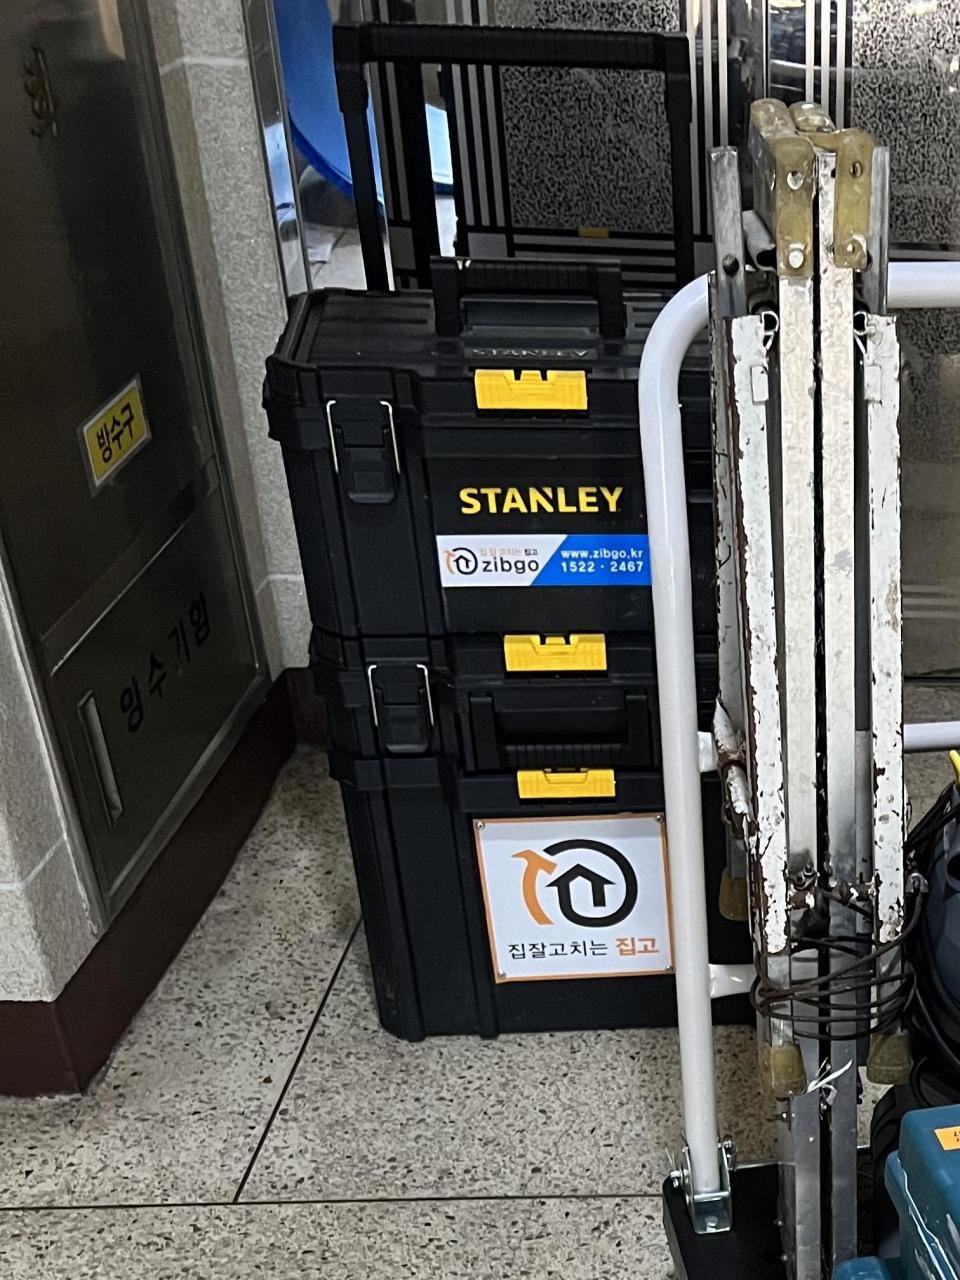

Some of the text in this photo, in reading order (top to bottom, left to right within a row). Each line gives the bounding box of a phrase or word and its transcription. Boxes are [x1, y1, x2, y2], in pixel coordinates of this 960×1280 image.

[97, 402, 135, 463] 방수구
[459, 486, 624, 515] STANLEY
[560, 548, 643, 560] www.zibgo.kr
[482, 556, 540, 575] zibgo
[561, 560, 644, 573] 1522 2467
[508, 936, 660, 960] 집잘고치는 집고
